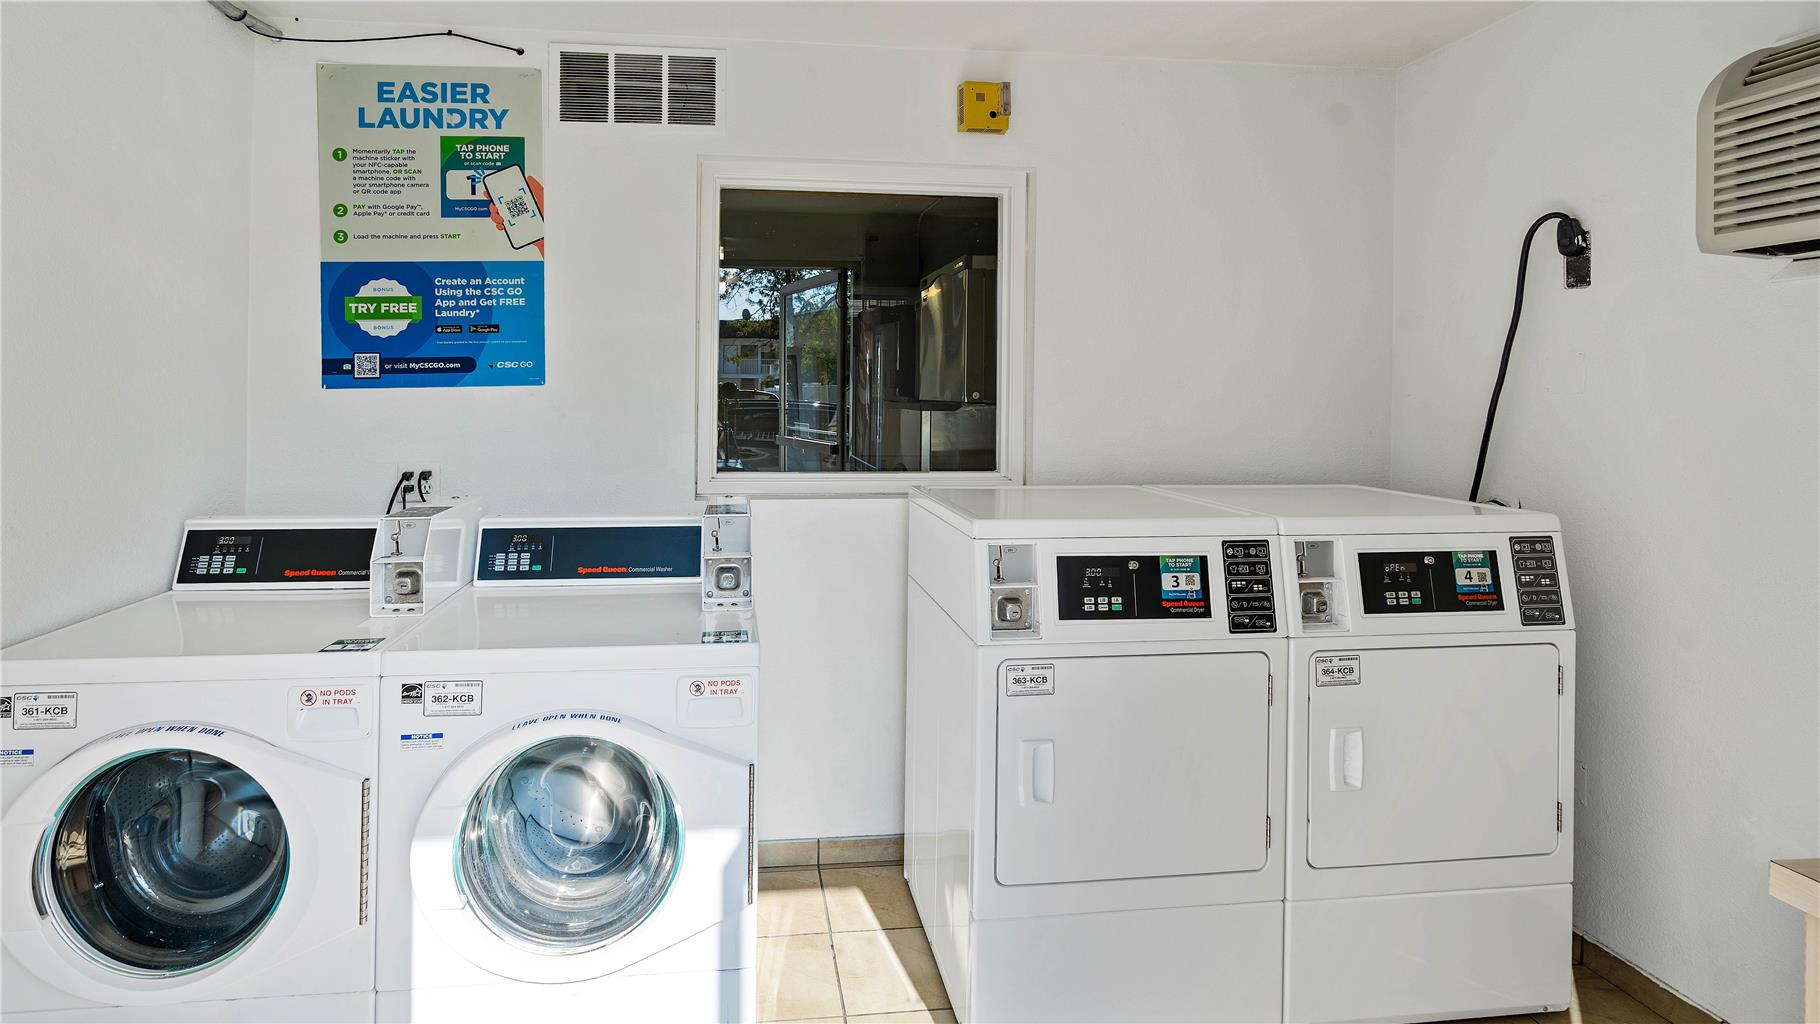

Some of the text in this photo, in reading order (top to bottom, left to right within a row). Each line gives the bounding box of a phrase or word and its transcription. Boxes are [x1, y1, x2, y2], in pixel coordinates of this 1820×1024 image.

[377, 82, 490, 104] EASIER
[358, 107, 509, 129] LAUNDRY
[337, 232, 344, 241] 3
[435, 288, 462, 296] Using
[435, 299, 456, 307] App
[349, 303, 417, 313] TRY FREE
[1086, 568, 1101, 576] 3.00
[1465, 571, 1473, 582] 4
[1172, 576, 1180, 588] 3
[1322, 667, 1354, 675] 364-KCB
[1013, 676, 1047, 684] 363-KCB
[22, 707, 68, 716] 361-KCB
[512, 719, 538, 730] LEAVE
[198, 728, 225, 737] DONE
